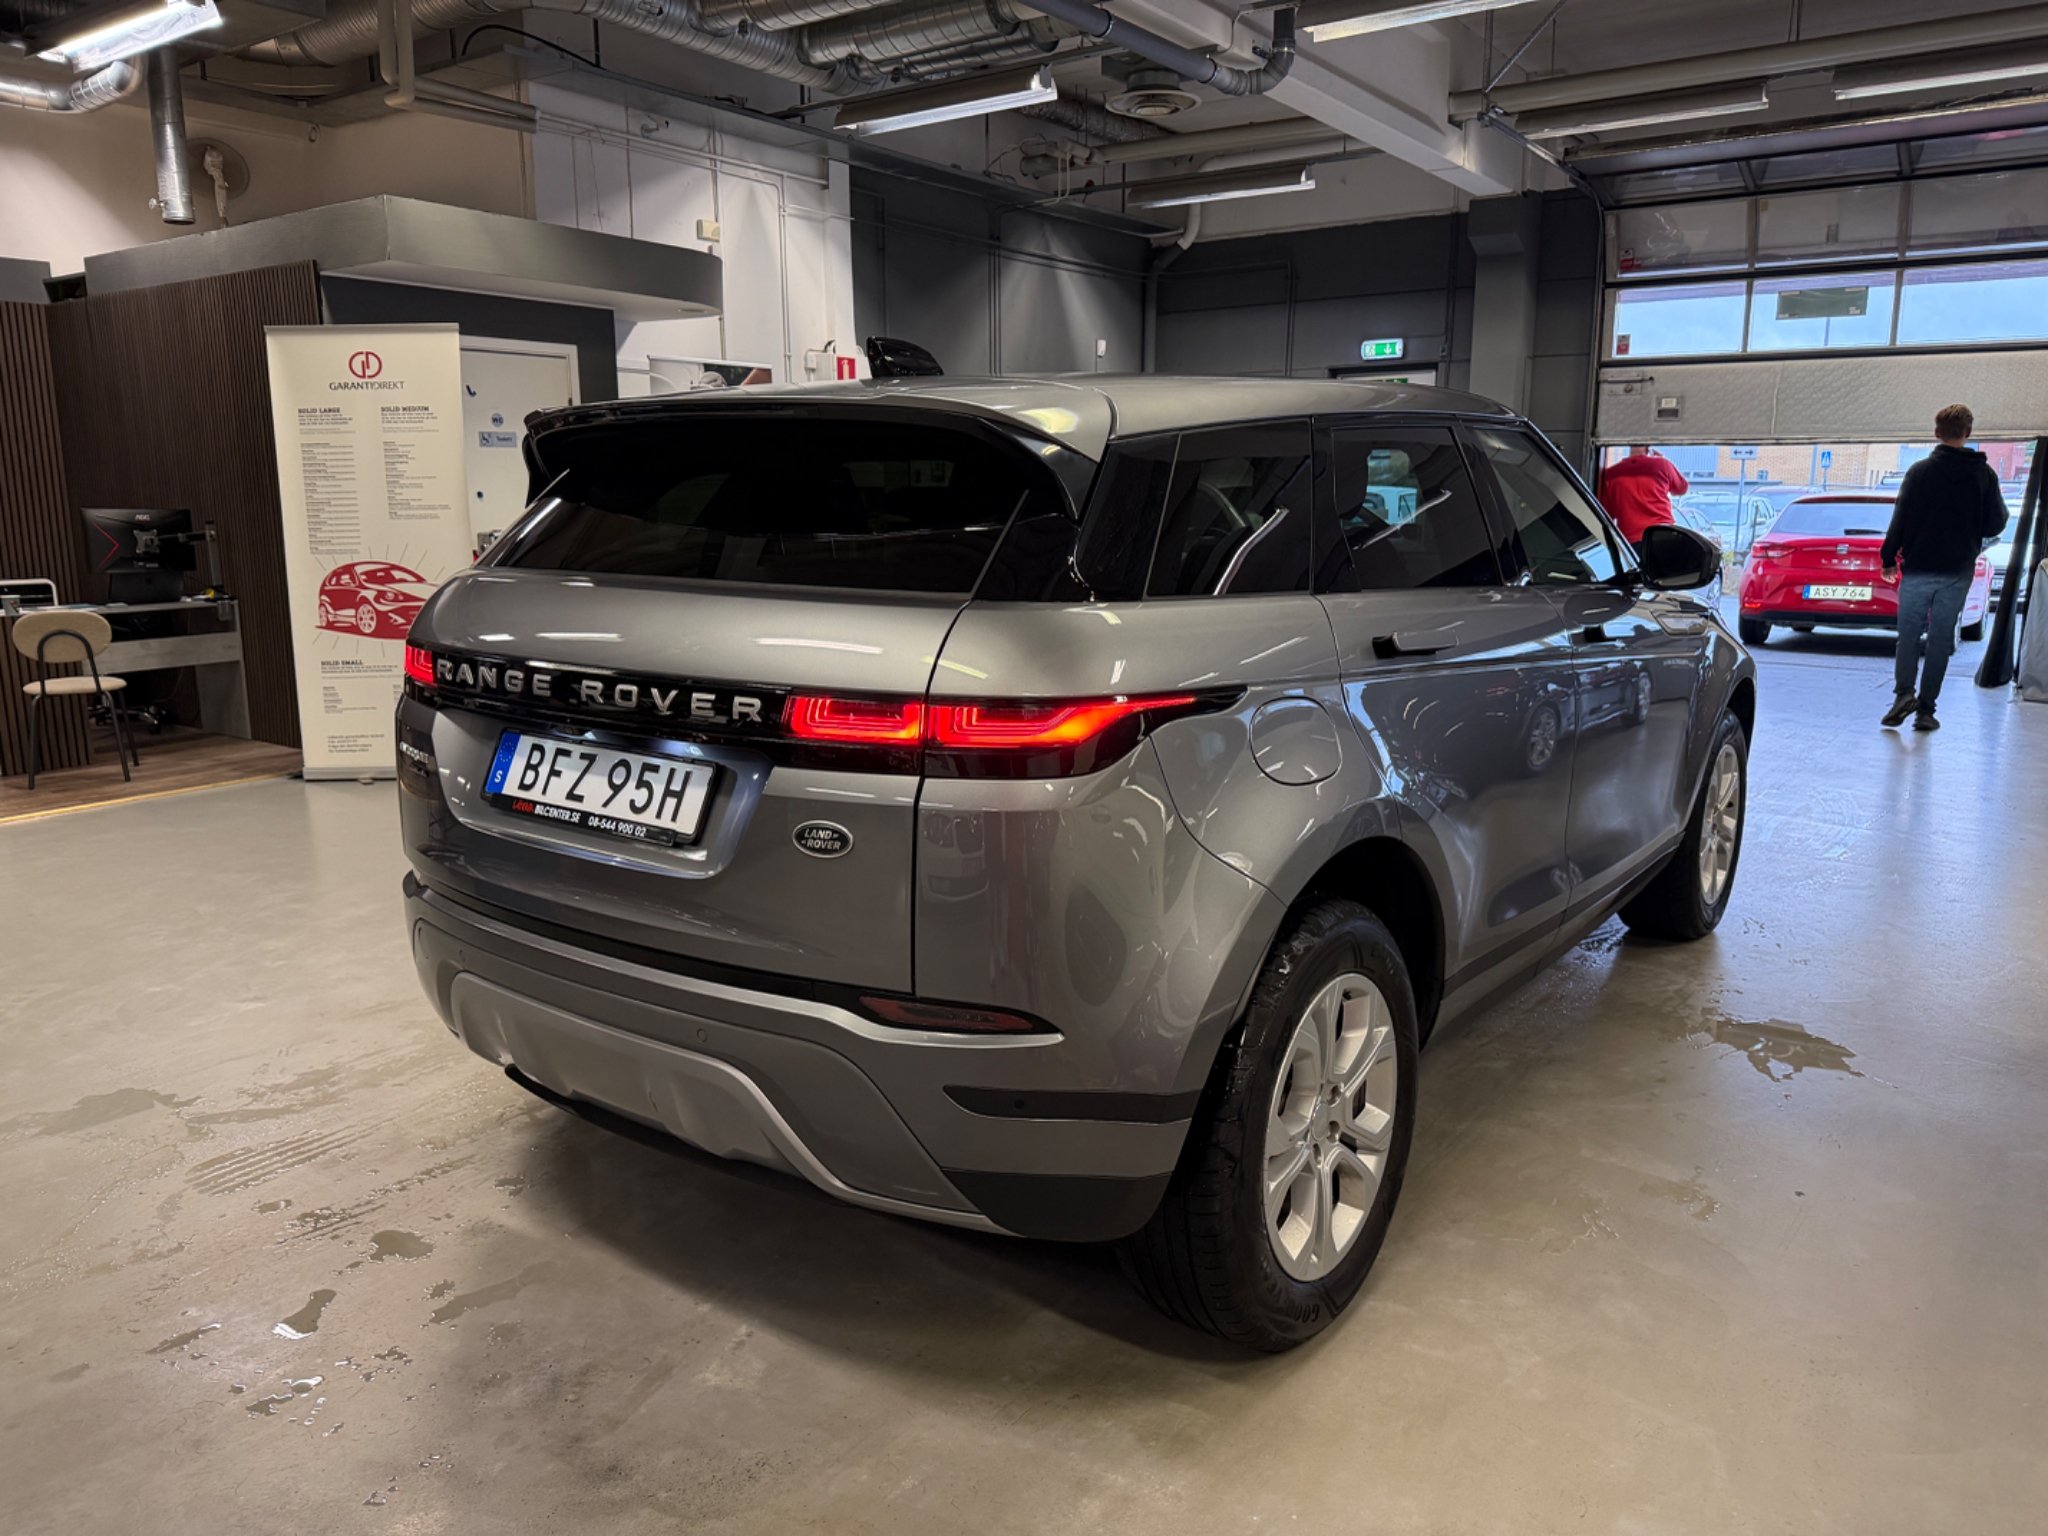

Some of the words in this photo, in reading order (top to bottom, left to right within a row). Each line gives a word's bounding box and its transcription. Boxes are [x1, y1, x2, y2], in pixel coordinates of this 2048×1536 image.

[1814, 587, 1838, 598] ASY
[1842, 588, 1866, 598] 764
[436, 658, 552, 697] RANGE
[579, 678, 763, 723] ROVER
[494, 769, 503, 784] S
[517, 742, 599, 804] BFZ
[600, 757, 694, 823] 95H
[617, 821, 634, 835] 900
[634, 826, 646, 838] 02
[804, 828, 833, 840] LAND
[806, 839, 842, 850] ROVER
